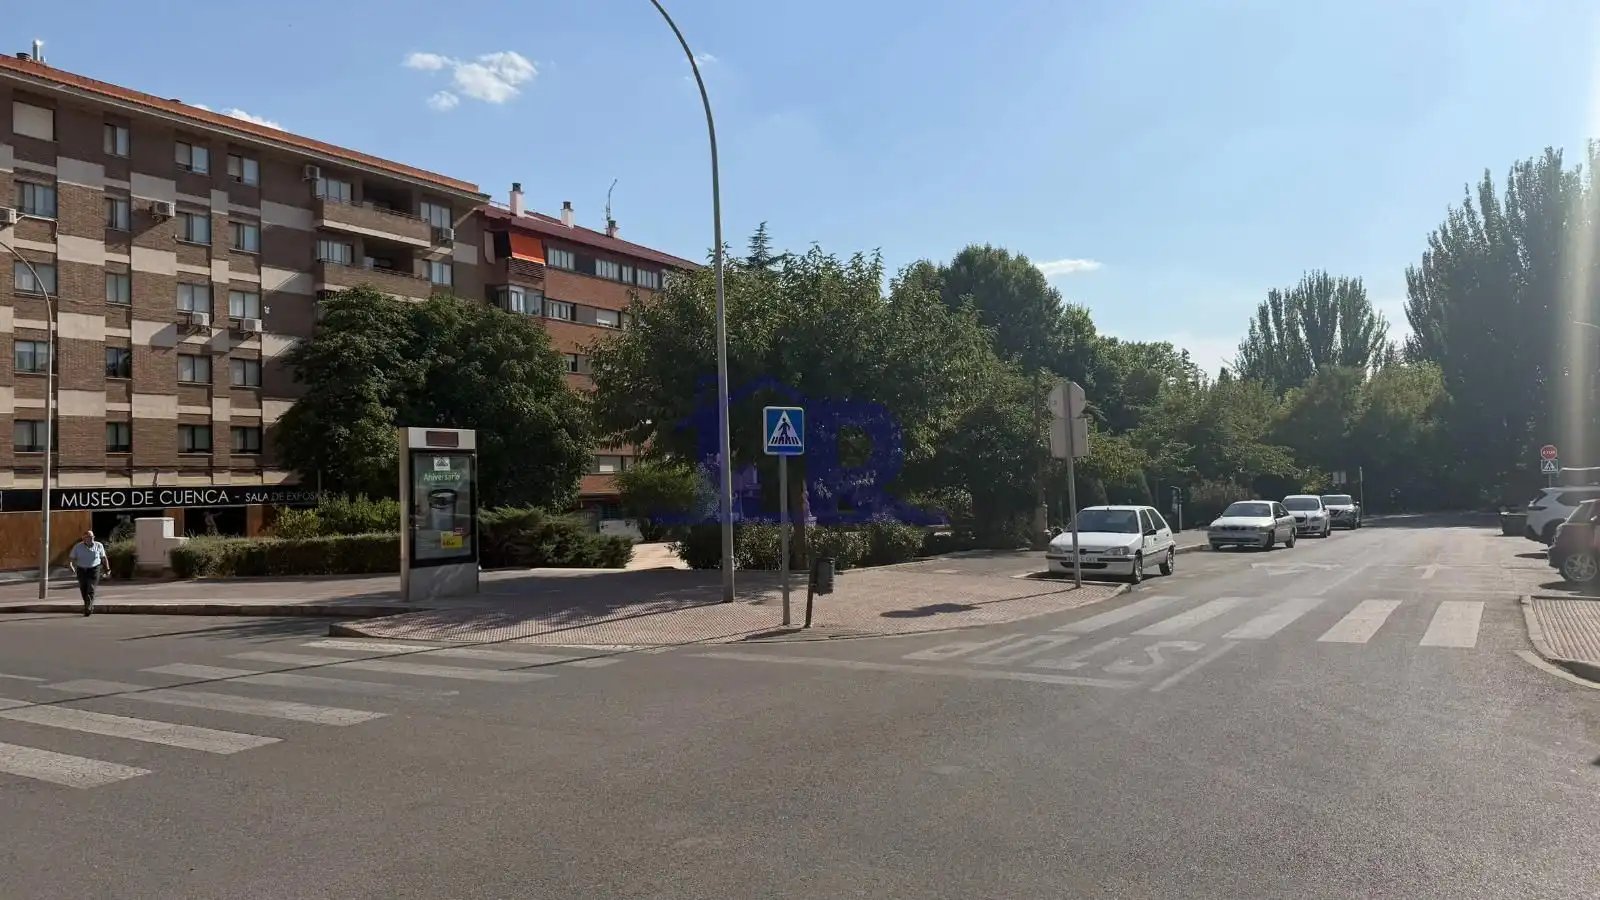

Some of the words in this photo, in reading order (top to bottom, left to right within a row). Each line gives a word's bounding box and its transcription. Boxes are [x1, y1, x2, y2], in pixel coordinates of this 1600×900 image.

[423, 472, 460, 481] Aniversario
[60, 491, 125, 508] MUSEO
[131, 491, 154, 505] DE
[159, 489, 229, 505] CUENCA
[245, 492, 269, 502] SALA
[271, 491, 284, 501] DE
[902, 633, 1206, 674] STOP
